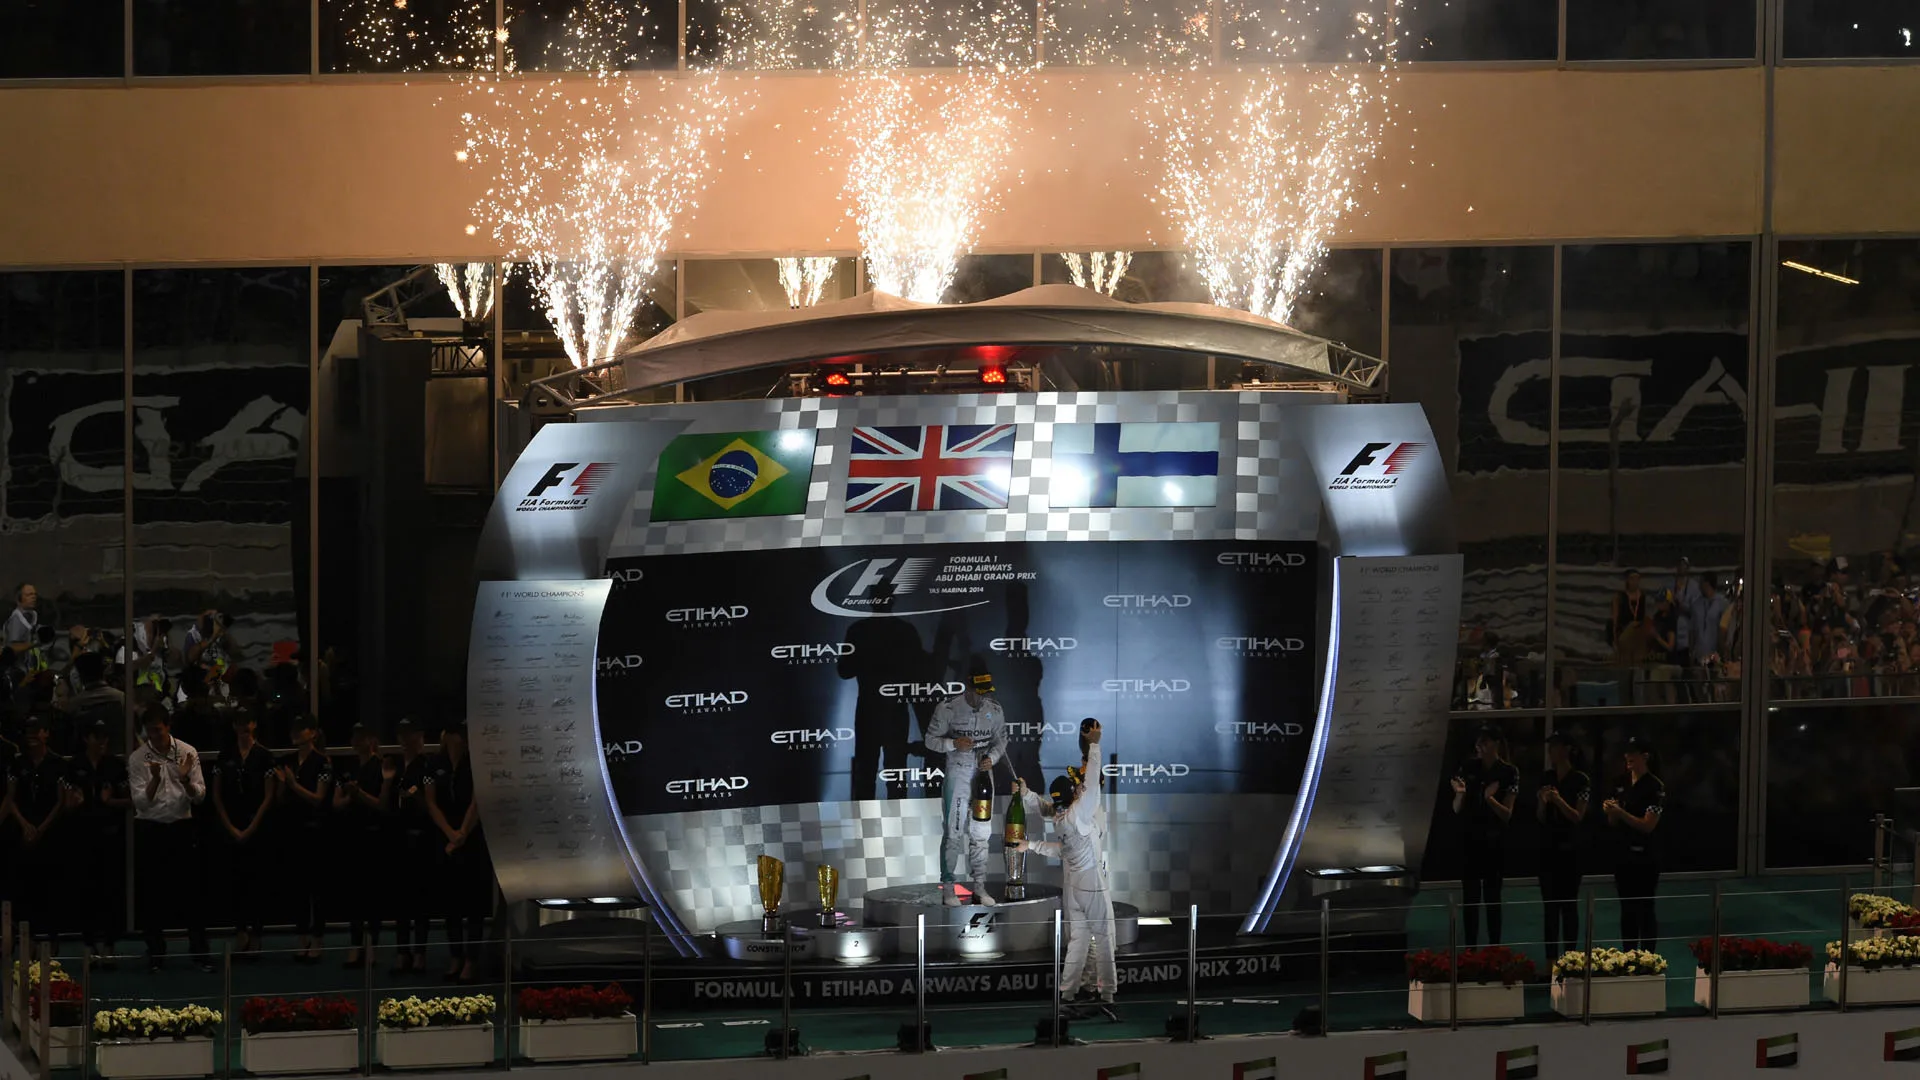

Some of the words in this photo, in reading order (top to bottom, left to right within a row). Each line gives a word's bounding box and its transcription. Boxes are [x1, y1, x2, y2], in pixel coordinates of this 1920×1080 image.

[1332, 477, 1350, 485] FIA
[949, 556, 991, 564] FORMULA
[993, 555, 998, 563] 1
[1217, 552, 1306, 566] ETIHAD
[943, 565, 973, 573] ETIHAD
[974, 564, 1013, 572] AIRWAYS
[935, 574, 954, 582] ABU
[955, 573, 982, 581] DHABI
[1016, 572, 1037, 580] PRIX
[540, 590, 585, 598] CHAMPIONS
[1103, 594, 1192, 608] ETIHAD
[665, 605, 749, 622] ETIHAD
[683, 620, 732, 630] AIRWAYS
[770, 642, 856, 659] ETIHAD
[990, 637, 1078, 651] ETIHAD
[1216, 636, 1305, 651] ETIHAD
[597, 654, 643, 671] HAD
[788, 657, 839, 665] AIRWAYS
[878, 681, 966, 697] ETIHAD
[1102, 679, 1191, 693] ETIHAD
[665, 690, 749, 708] ETIHAD
[683, 706, 732, 715] AIRWAYS
[770, 727, 856, 744] ETIHAD
[1006, 722, 1077, 736] TIHAD
[1214, 721, 1304, 736] ETIHAD
[879, 767, 946, 782] ETIHA
[1101, 763, 1190, 777] ETIHAD
[665, 776, 750, 794] ETIHAD
[683, 792, 733, 800] AIRWAYS
[853, 940, 860, 948] 2
[694, 981, 795, 998] FORMULA
[803, 981, 812, 997] 1
[822, 979, 894, 997] ETIHAD
[900, 975, 991, 994] ARWAYS
[997, 973, 1038, 991] ABU
[1116, 964, 1182, 985] GRAND
[1235, 955, 1281, 975] 2014
